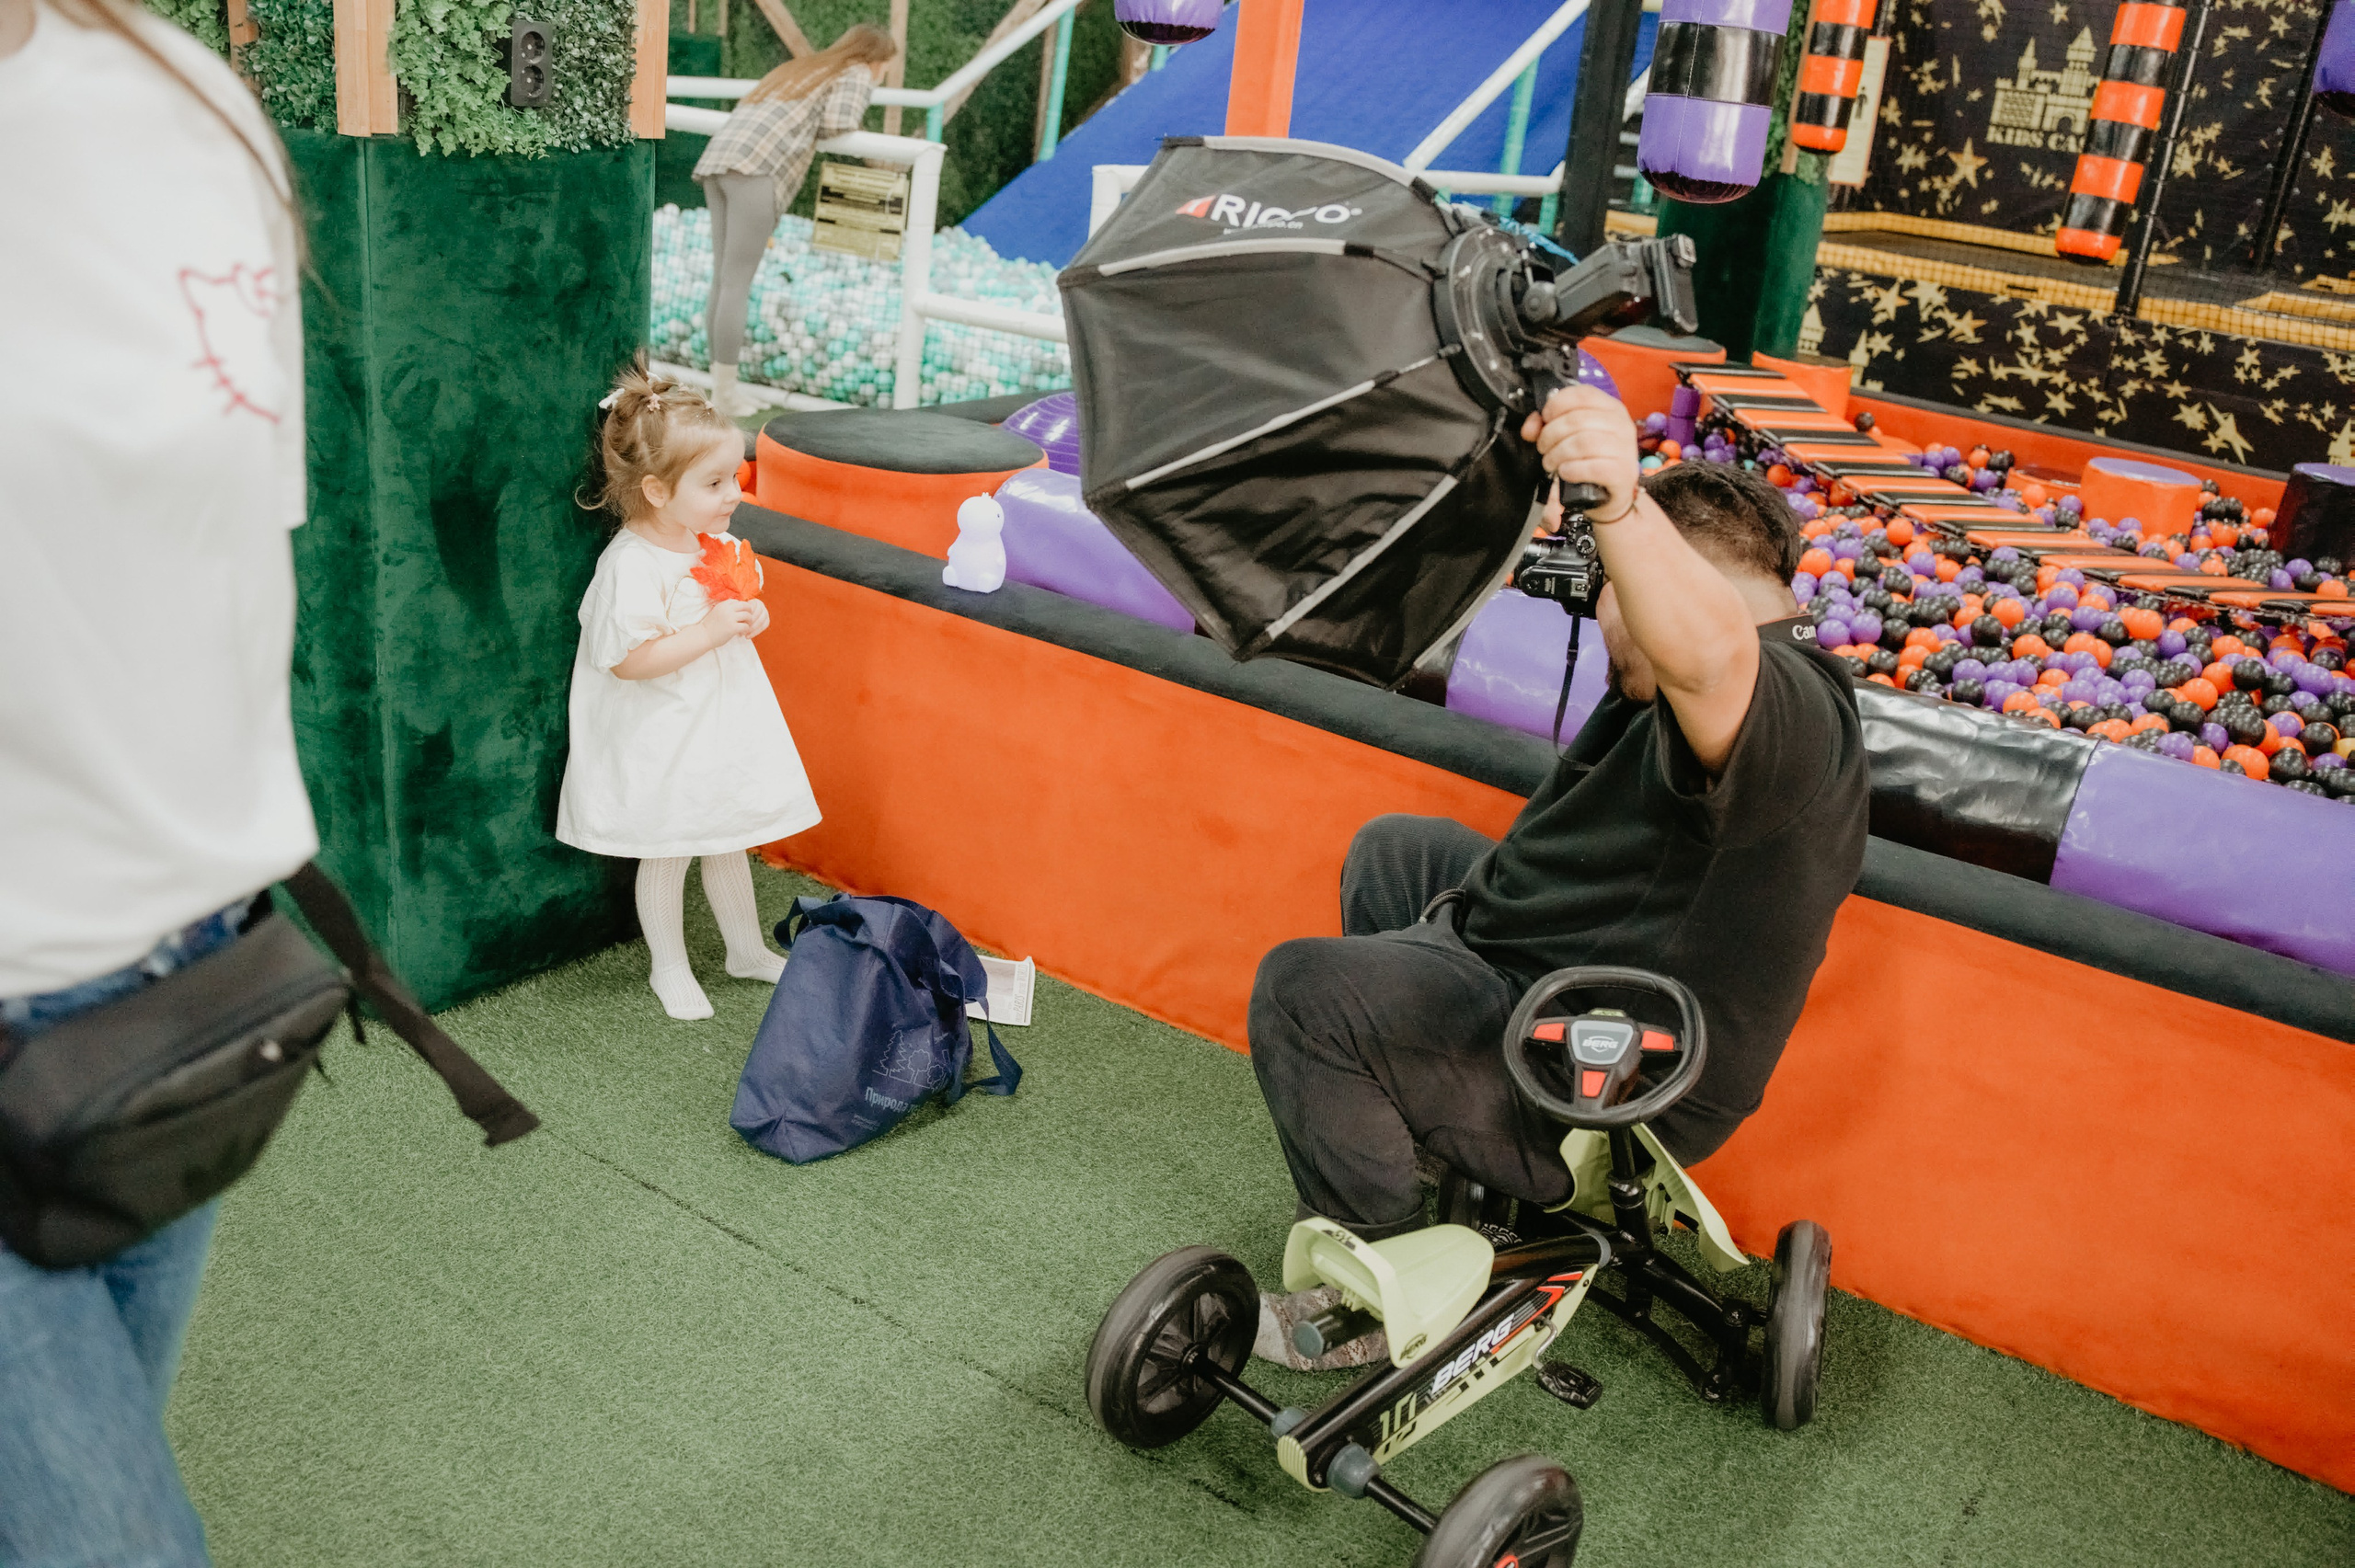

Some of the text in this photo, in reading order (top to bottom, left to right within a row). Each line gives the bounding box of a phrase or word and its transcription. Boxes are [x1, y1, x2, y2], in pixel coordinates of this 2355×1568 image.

[1986, 125, 2044, 148] KIDS
[1582, 1038, 1619, 1049] BERG
[866, 1086, 909, 1113] Природа
[1431, 1313, 1515, 1395] BERG
